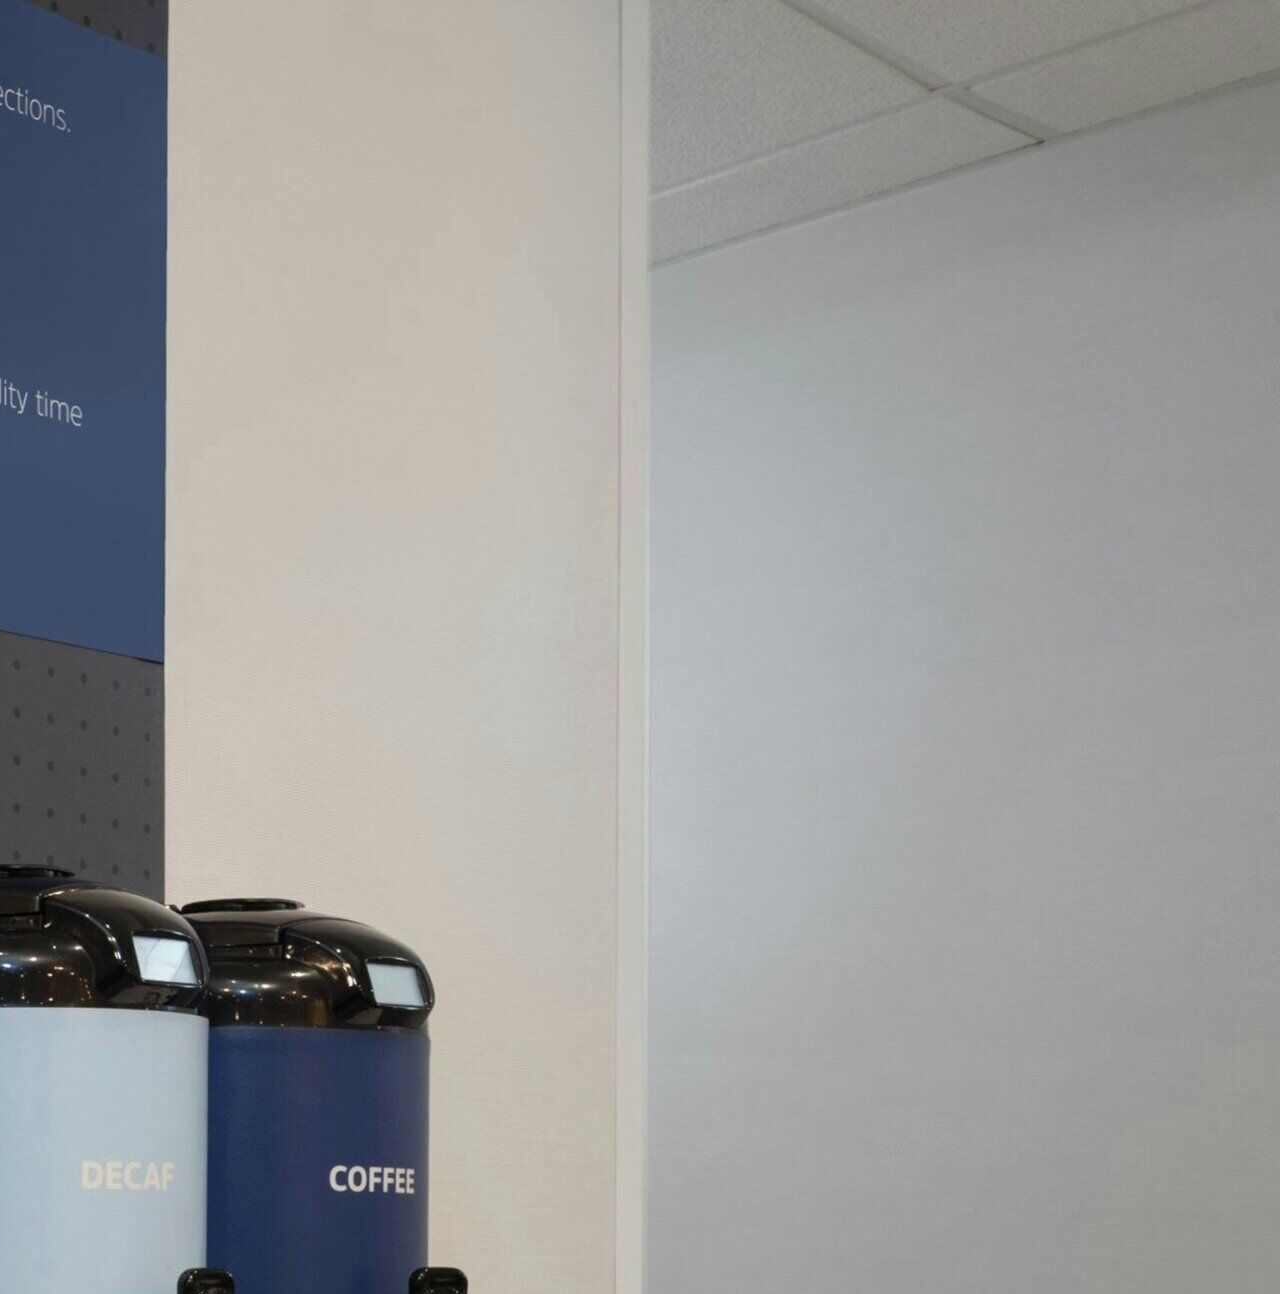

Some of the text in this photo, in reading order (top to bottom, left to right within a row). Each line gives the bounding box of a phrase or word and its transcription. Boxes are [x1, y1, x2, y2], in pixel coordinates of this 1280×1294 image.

[35, 387, 83, 427] time
[81, 1160, 176, 1191] DECAF
[329, 1164, 416, 1195] COFFEE
